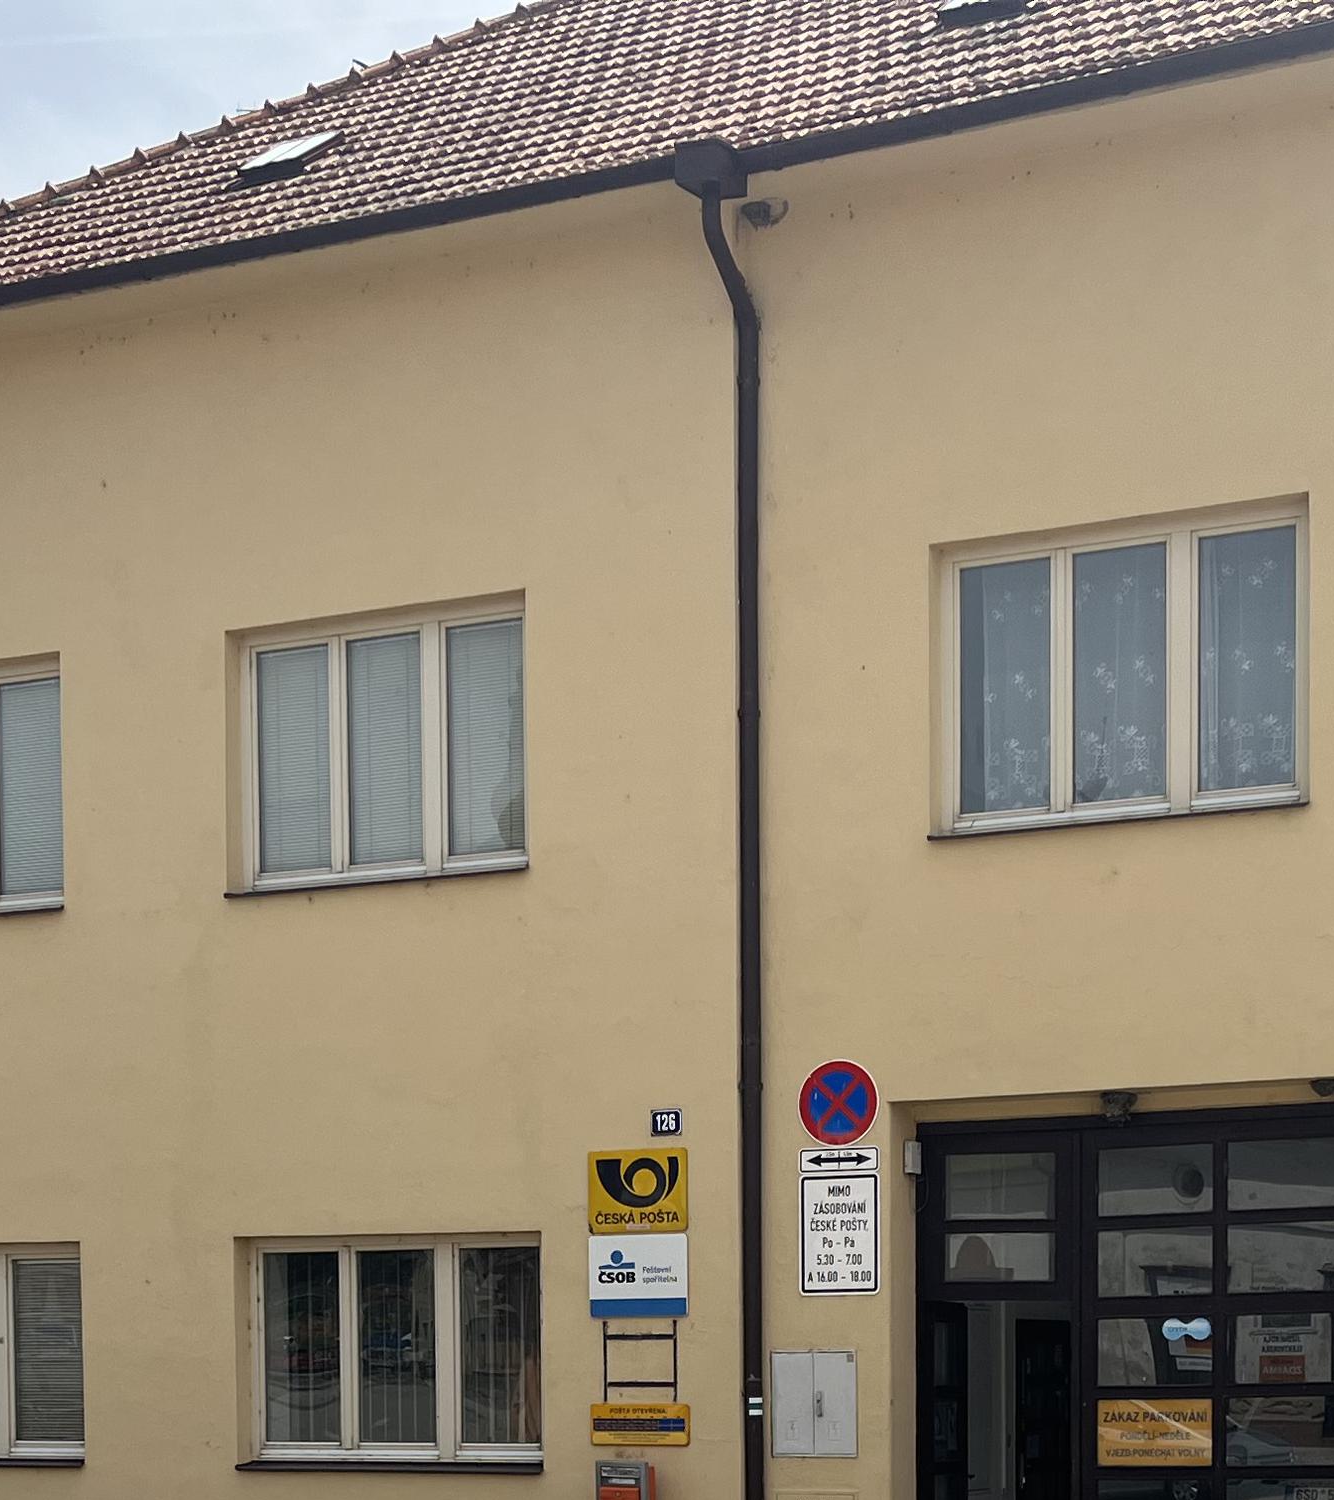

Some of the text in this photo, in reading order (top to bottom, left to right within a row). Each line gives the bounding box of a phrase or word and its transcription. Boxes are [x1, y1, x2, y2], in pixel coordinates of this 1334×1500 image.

[656, 1113, 676, 1132] 126
[827, 1185, 851, 1197] MIMO
[813, 1200, 866, 1215] ZÁSOBOVÁNÍ
[595, 1208, 680, 1225] ČESKÁ POŠTA
[810, 1217, 837, 1232] ČESKÉ
[822, 1236, 833, 1248] Po
[816, 1254, 835, 1266] 5.30
[845, 1253, 863, 1266] 7.00
[598, 1271, 636, 1284] ČSOB
[807, 1272, 813, 1283] A
[817, 1271, 838, 1283] 16.00
[850, 1270, 872, 1283] 18.00
[1103, 1408, 1140, 1423] ZÁKAZ
